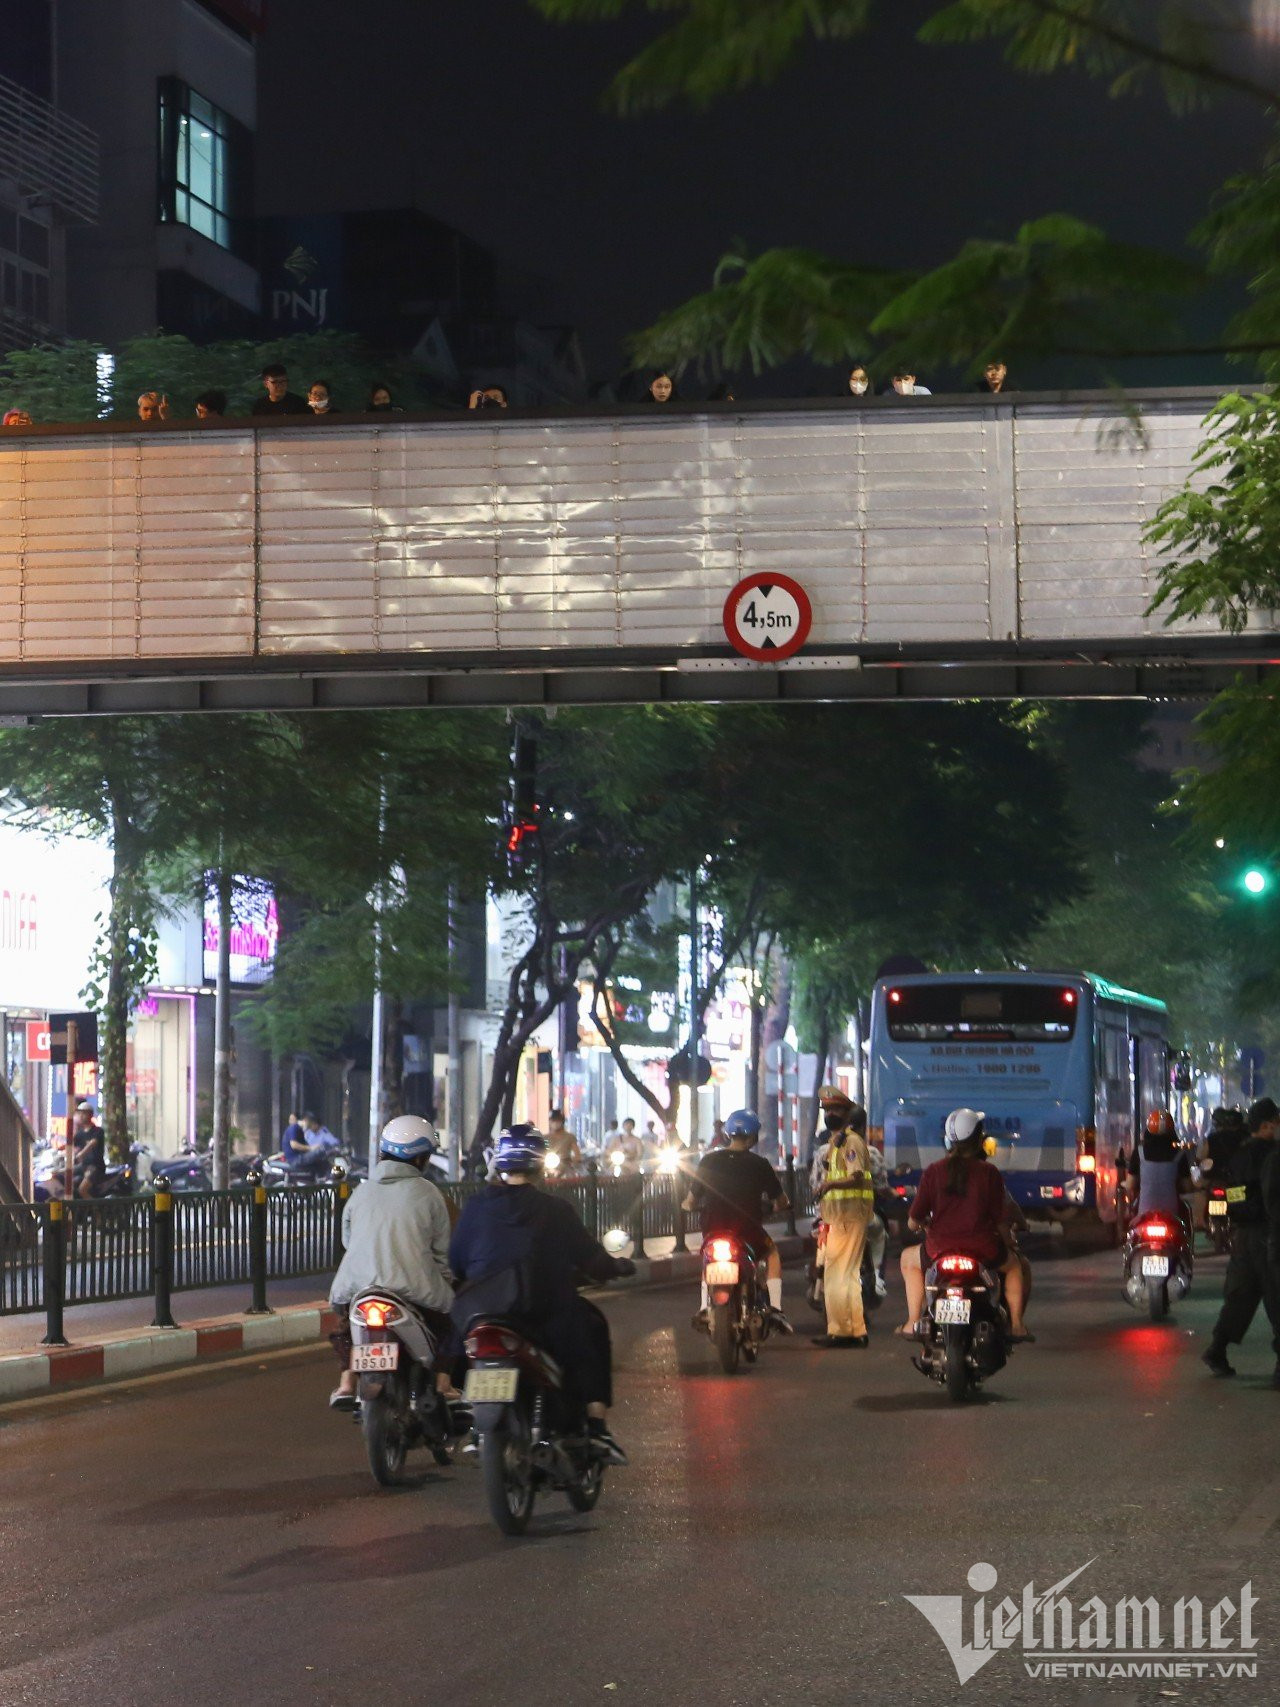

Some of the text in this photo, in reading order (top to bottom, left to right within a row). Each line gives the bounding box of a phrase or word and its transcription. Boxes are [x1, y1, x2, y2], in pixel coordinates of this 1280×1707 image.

[273, 288, 328, 326] PNJ
[743, 601, 792, 628] 4,5m
[355, 1357, 395, 1370] 185.01
